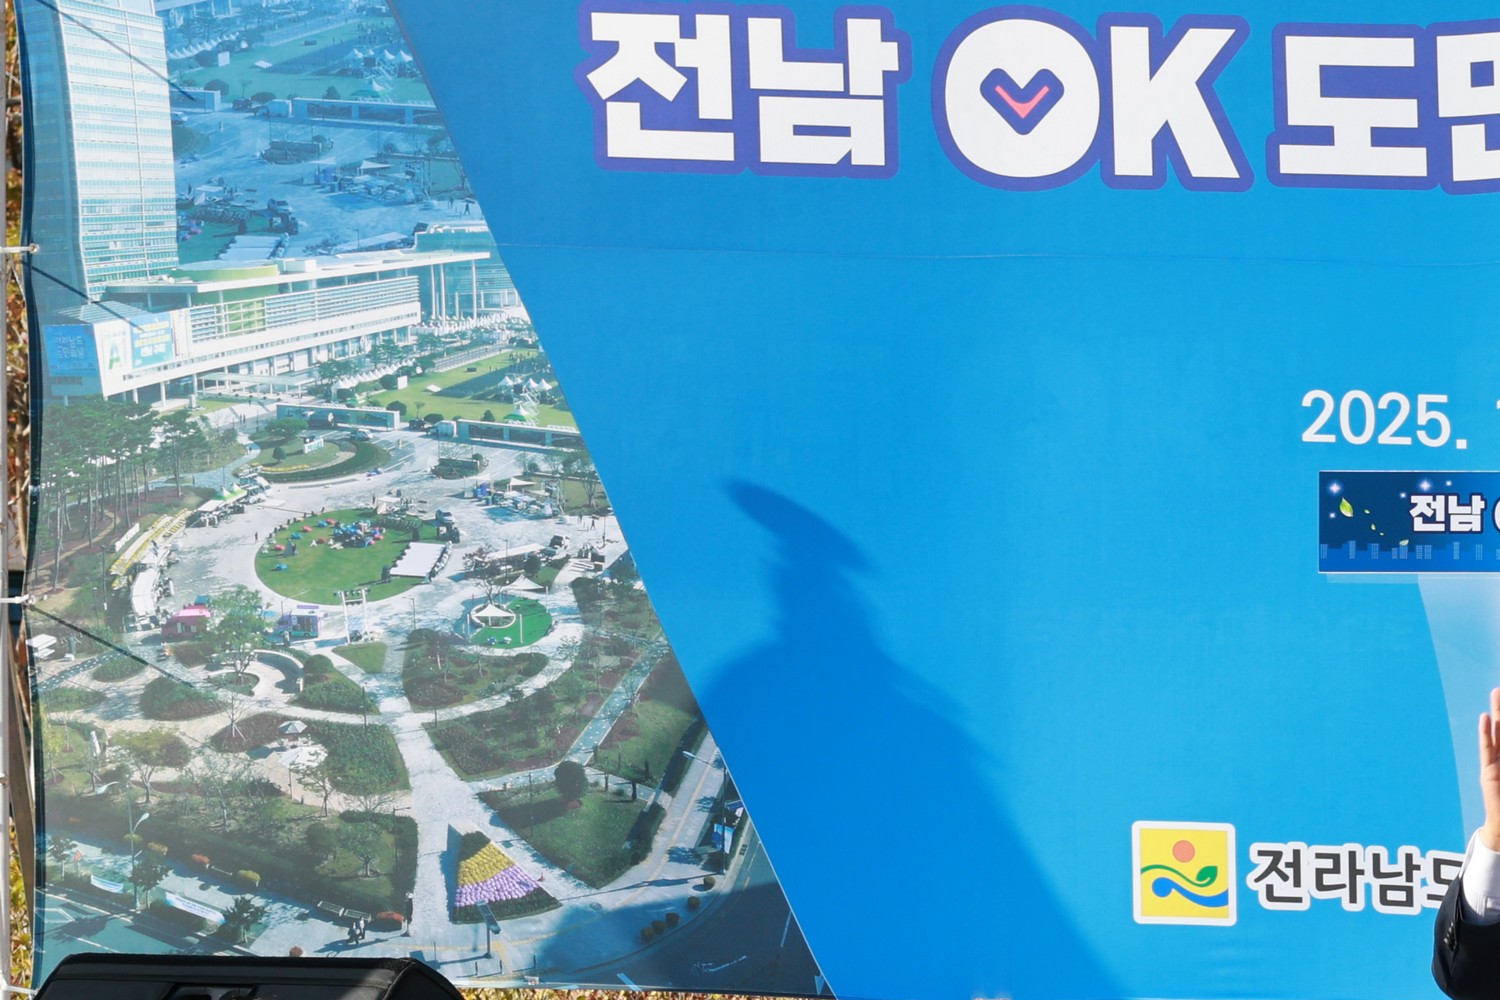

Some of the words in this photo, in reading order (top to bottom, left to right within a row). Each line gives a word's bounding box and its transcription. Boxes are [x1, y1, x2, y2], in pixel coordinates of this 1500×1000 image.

[586, 12, 899, 167] 전남
[944, 18, 1241, 179] OK
[1301, 389, 1468, 450] 2025.
[1409, 494, 1486, 532] 전남
